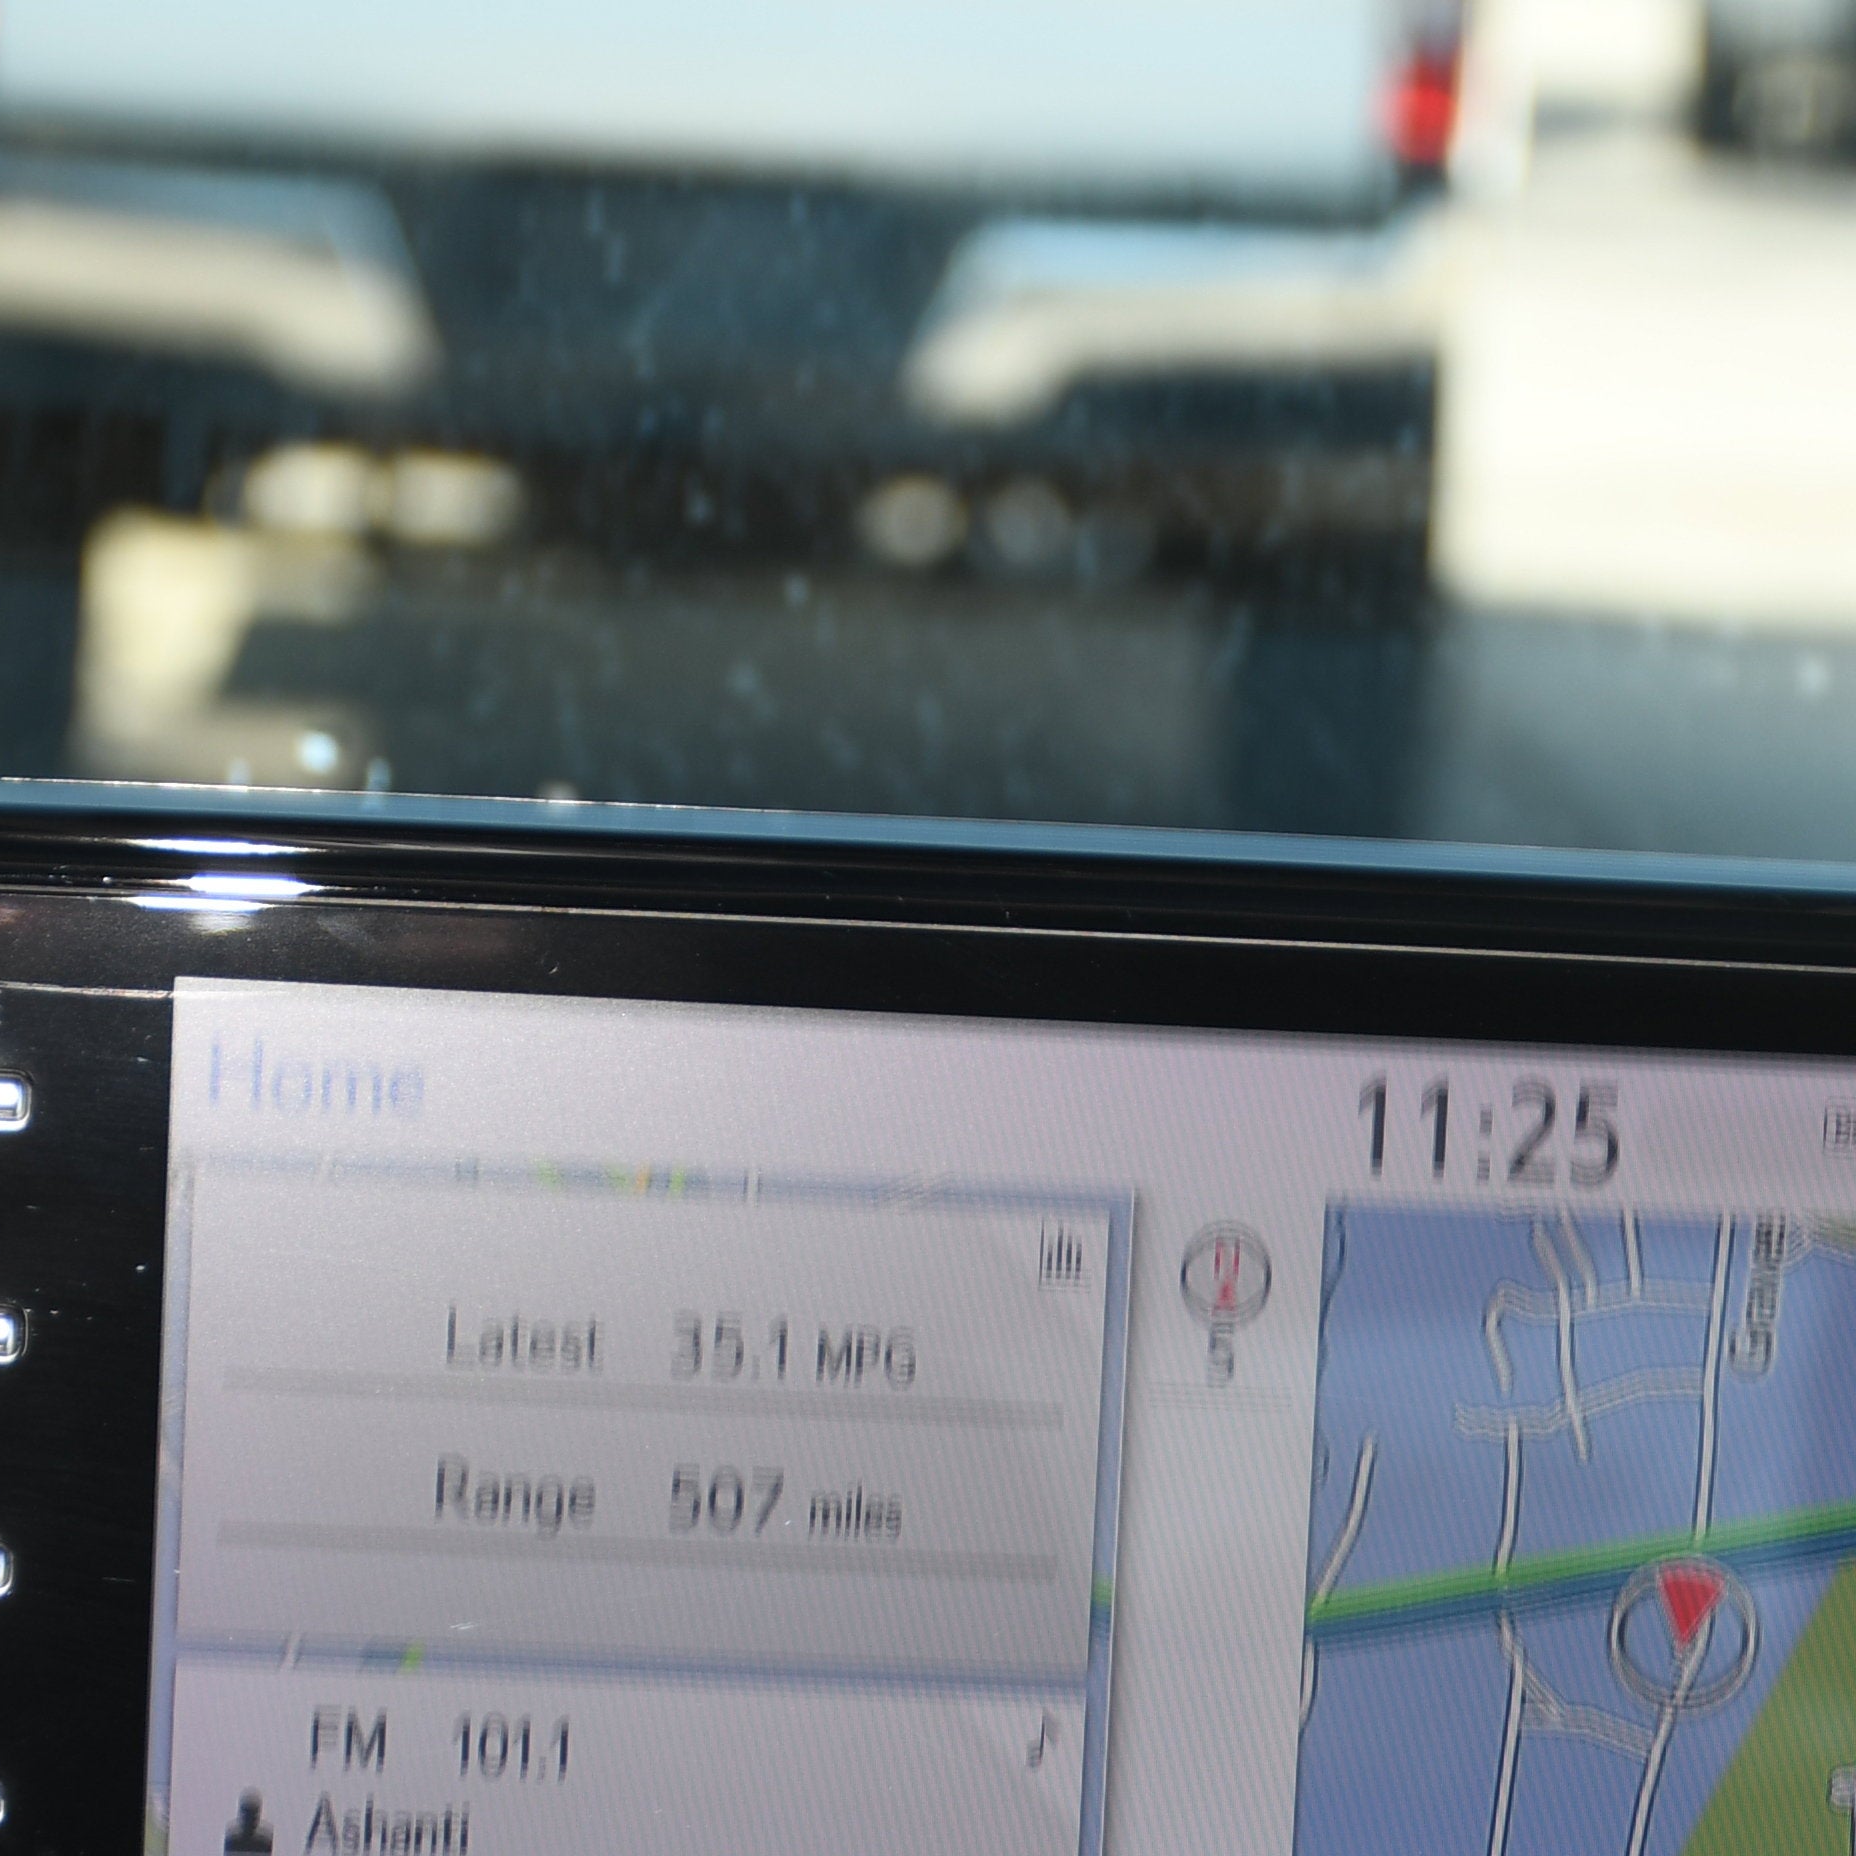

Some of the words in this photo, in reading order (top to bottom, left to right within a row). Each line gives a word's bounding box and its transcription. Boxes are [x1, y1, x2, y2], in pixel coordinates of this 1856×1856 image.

[208, 1030, 424, 1118] Home
[1357, 1072, 1620, 1188] 11:25
[443, 1303, 603, 1379] Latest
[671, 1308, 790, 1387] 35.1
[816, 1321, 917, 1391] MPG
[434, 1453, 596, 1540] Range
[670, 1462, 785, 1538] 507
[807, 1479, 904, 1545] miles
[310, 1705, 388, 1775] FM
